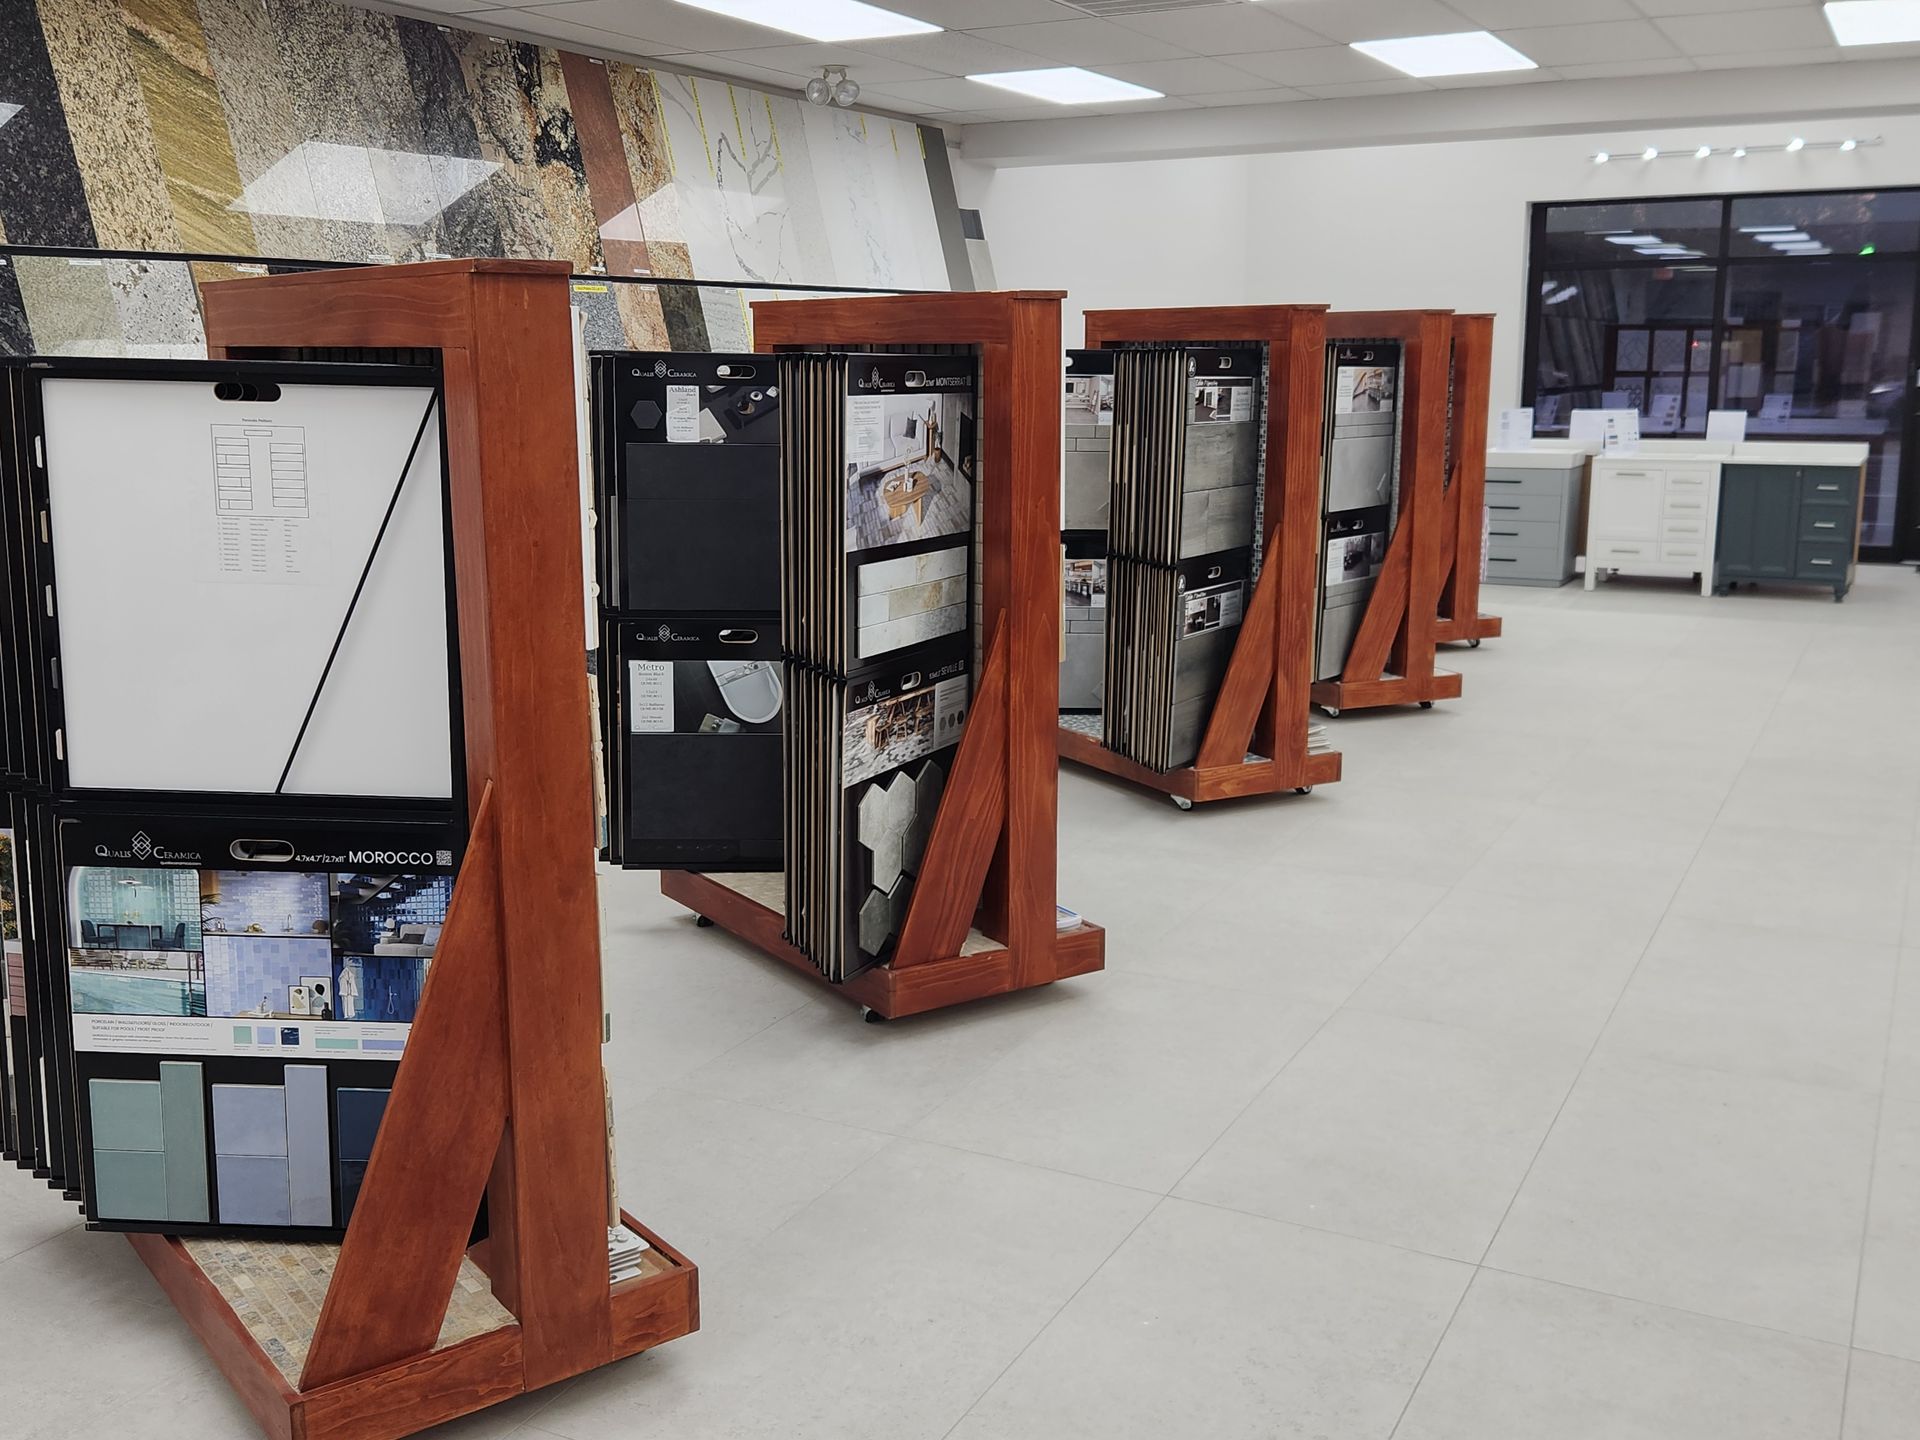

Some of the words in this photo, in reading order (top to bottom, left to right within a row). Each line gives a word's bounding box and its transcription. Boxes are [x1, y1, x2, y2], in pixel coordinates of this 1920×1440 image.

[637, 663, 665, 672] Metro
[95, 844, 132, 858] QUALIS
[153, 846, 201, 860] CERAMICA
[348, 850, 434, 866] MOROCCO
